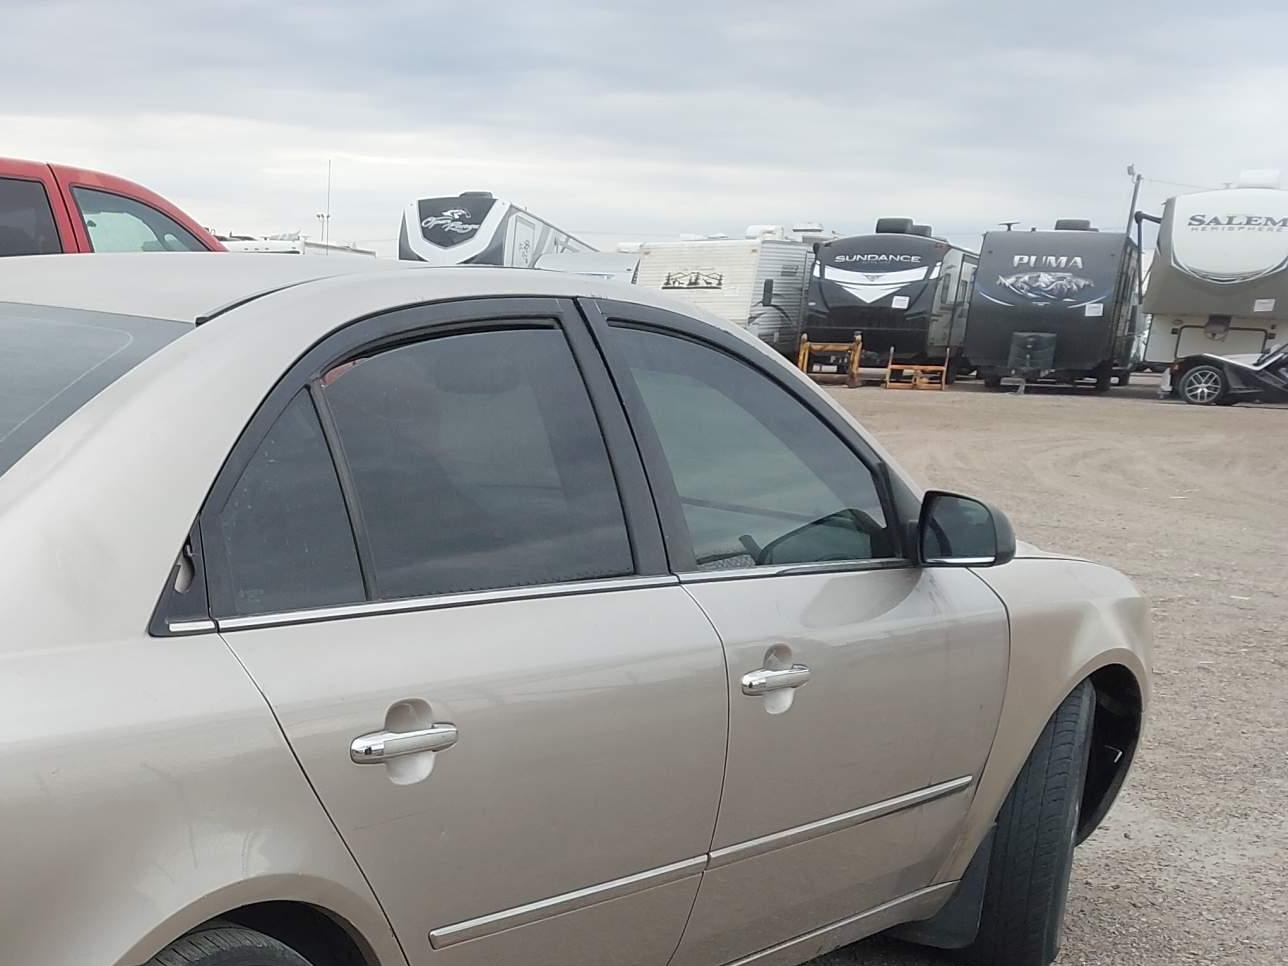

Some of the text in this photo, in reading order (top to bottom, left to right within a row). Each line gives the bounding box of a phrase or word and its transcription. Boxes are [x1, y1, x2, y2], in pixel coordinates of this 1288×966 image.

[1187, 214, 1288, 227] SALEM
[834, 254, 921, 263] SUNDANCE
[1013, 255, 1083, 269] PUMA
